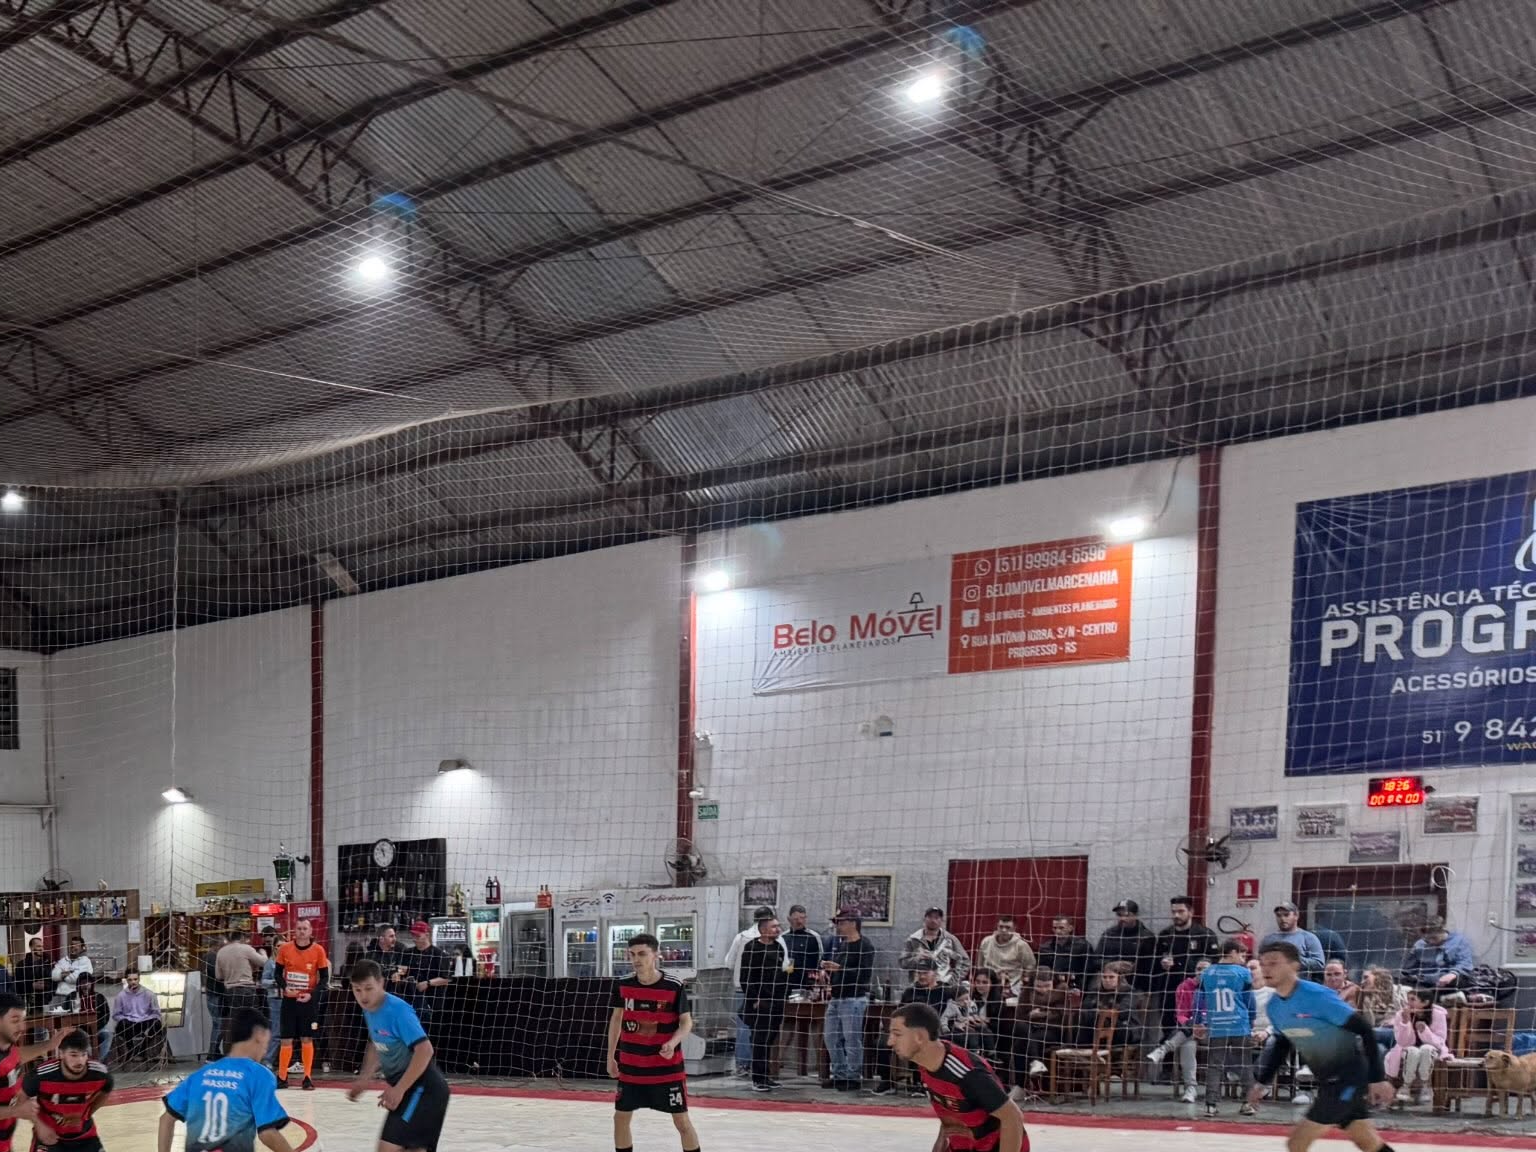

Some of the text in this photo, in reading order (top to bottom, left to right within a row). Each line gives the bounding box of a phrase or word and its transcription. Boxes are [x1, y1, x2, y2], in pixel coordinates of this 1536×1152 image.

[1323, 588, 1484, 619] ASSISTÊNCIA
[773, 605, 943, 649] Belo Móvel
[1082, 622, 1118, 636] CENTRO
[1422, 730, 1441, 744] 51
[1454, 721, 1472, 742] 9
[1213, 988, 1236, 1012] 10
[197, 1091, 229, 1143] 10
